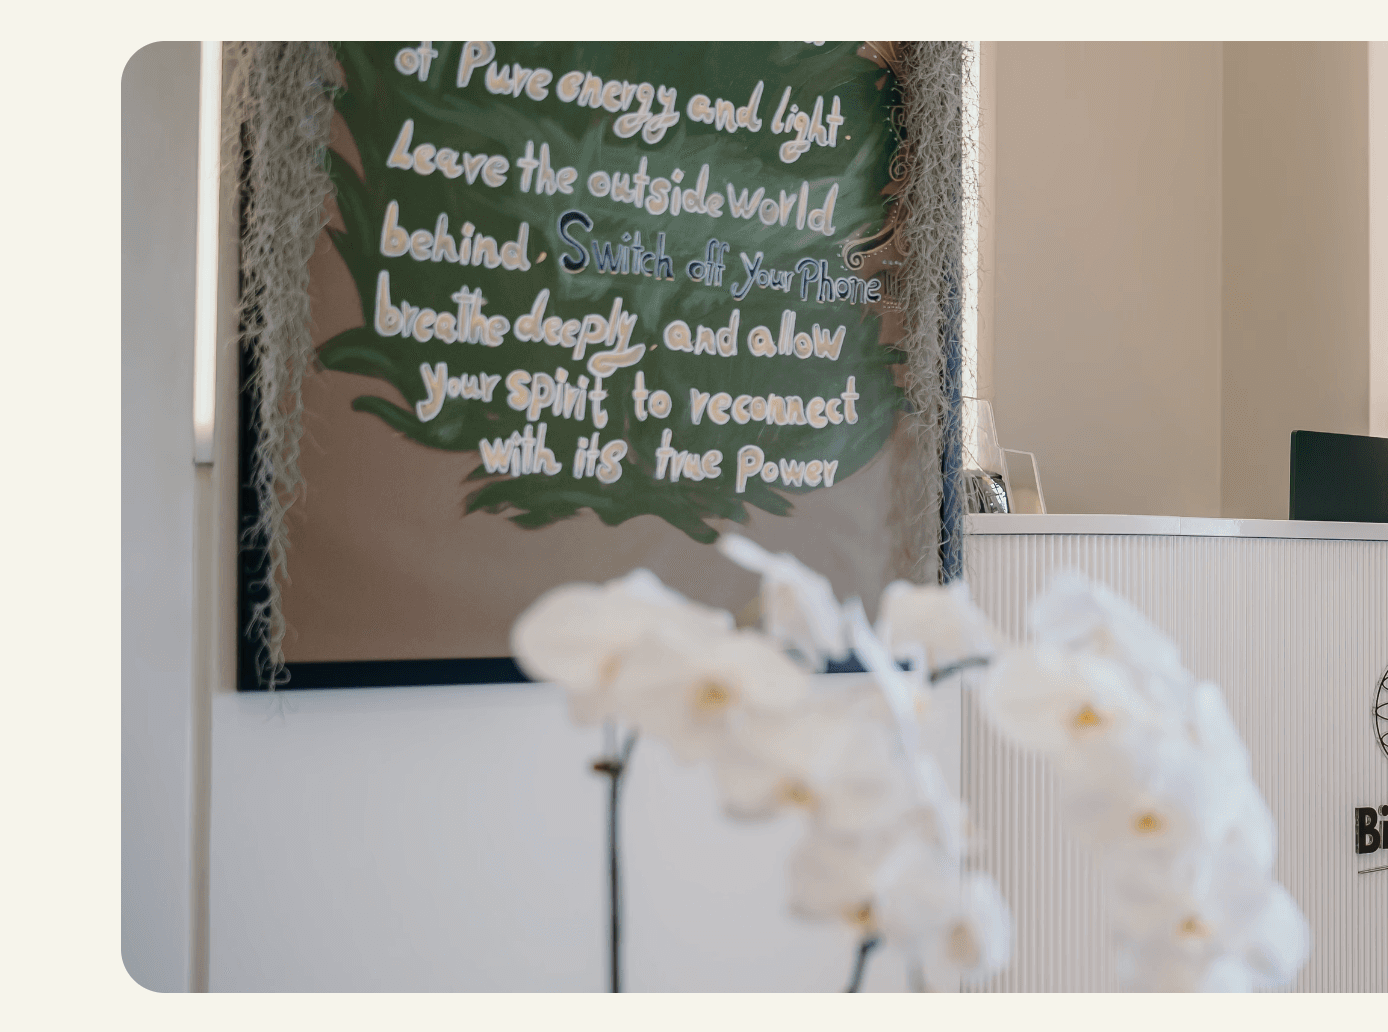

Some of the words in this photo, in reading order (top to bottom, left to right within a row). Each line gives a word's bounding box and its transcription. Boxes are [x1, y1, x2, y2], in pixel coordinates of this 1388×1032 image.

[556, 71, 680, 145] energy
[687, 80, 763, 133] and
[386, 118, 510, 188] Leave
[516, 140, 578, 196] the
[587, 156, 725, 217] outside
[557, 209, 675, 282] Switch
[686, 238, 731, 288] off
[375, 270, 510, 348] breathe
[663, 308, 740, 358] and
[747, 309, 846, 361] allow
[416, 362, 502, 423] your
[505, 367, 608, 429] spirit
[632, 371, 673, 422] to
[690, 376, 860, 429] reconnect
[480, 422, 562, 478] with
[573, 432, 628, 484] its
[654, 428, 723, 482] true
